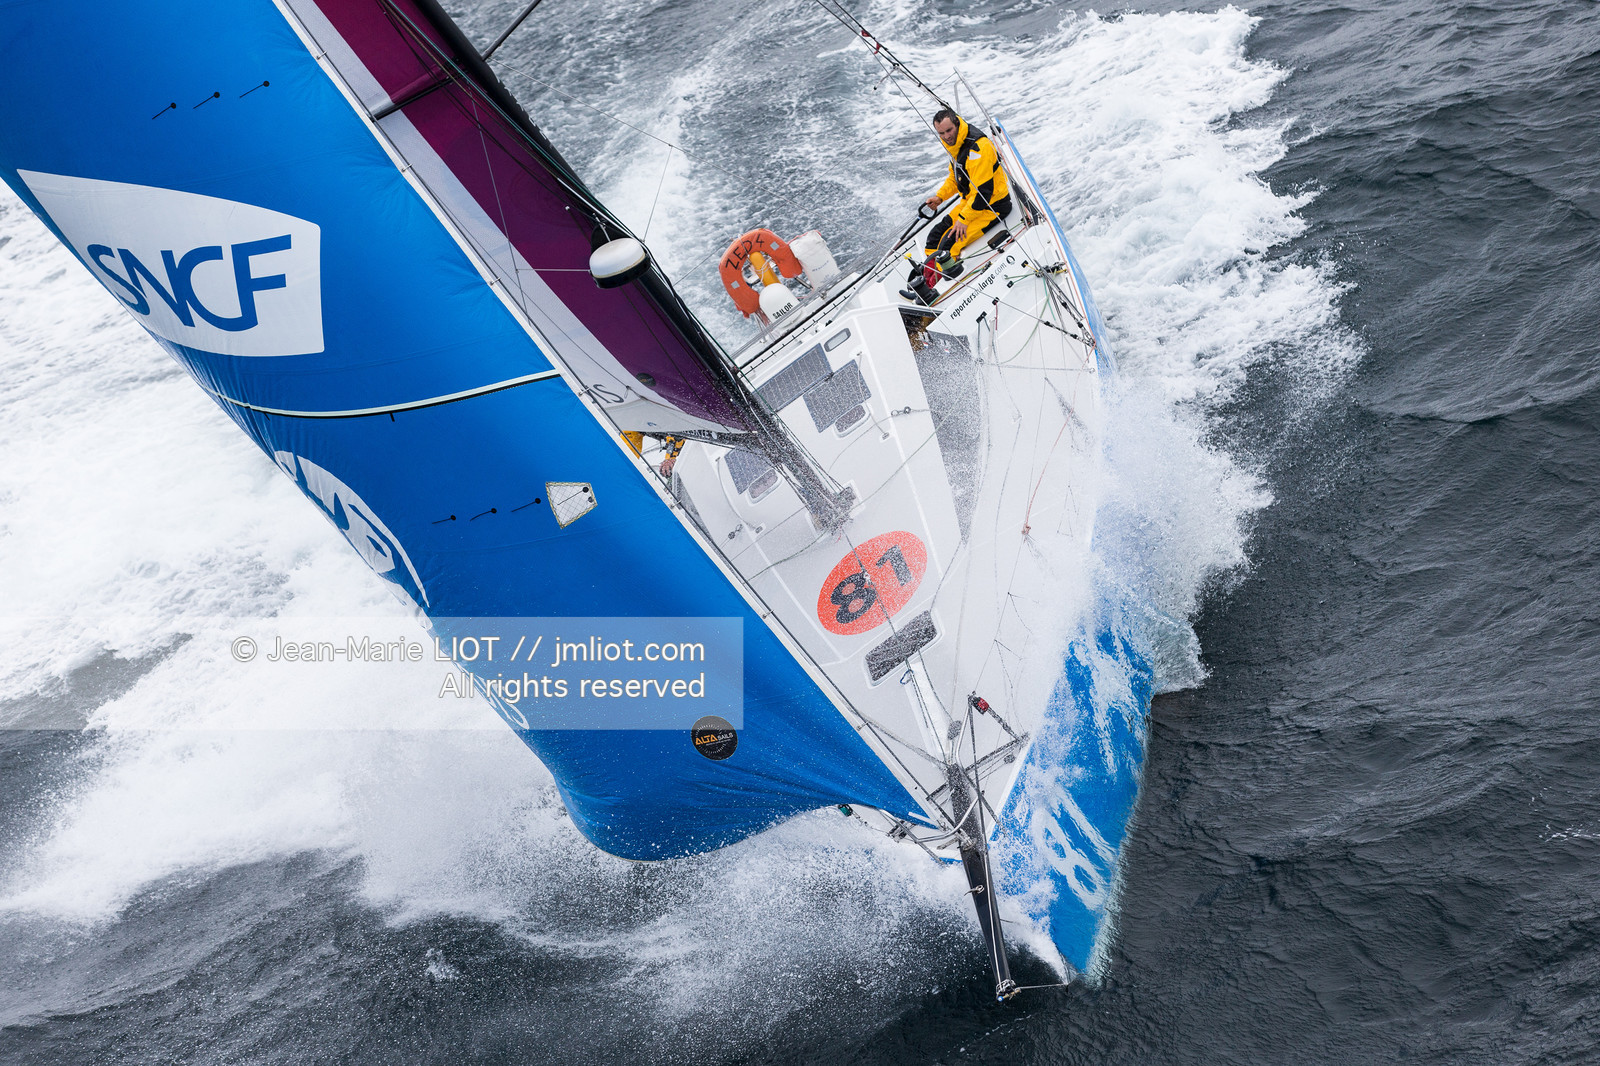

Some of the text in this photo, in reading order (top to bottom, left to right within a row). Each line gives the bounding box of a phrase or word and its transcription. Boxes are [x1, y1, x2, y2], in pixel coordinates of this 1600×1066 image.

[725, 239, 753, 270] ZED
[87, 234, 292, 332] SNCF
[772, 302, 793, 319] SAILOR
[830, 544, 913, 624] 81
[695, 734, 718, 746] ALTA
